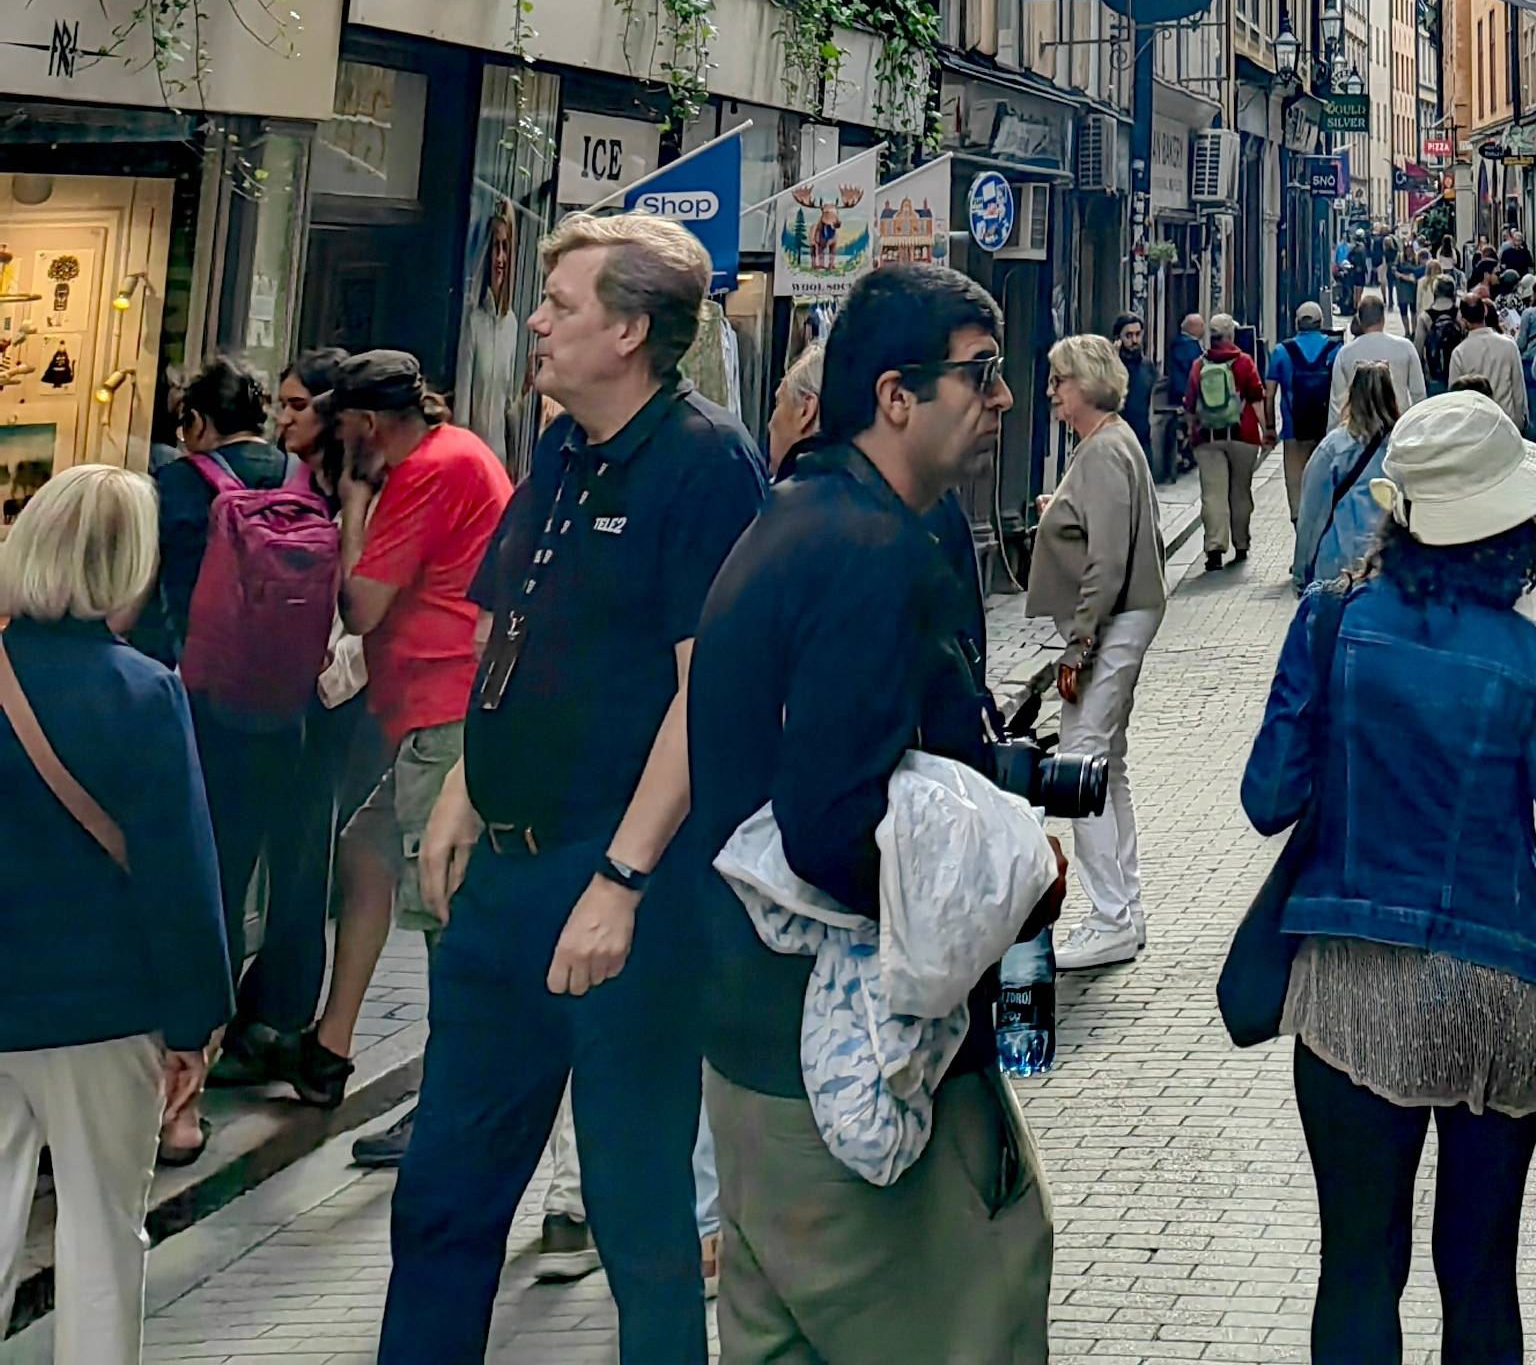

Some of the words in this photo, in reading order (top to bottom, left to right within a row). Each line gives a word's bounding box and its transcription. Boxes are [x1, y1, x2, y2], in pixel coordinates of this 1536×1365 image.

[1327, 117, 1366, 128] SILVER
[1427, 142, 1450, 152] PIZZA
[583, 135, 622, 181] ICE
[643, 196, 712, 219] Shop
[593, 517, 628, 534] TELE2
